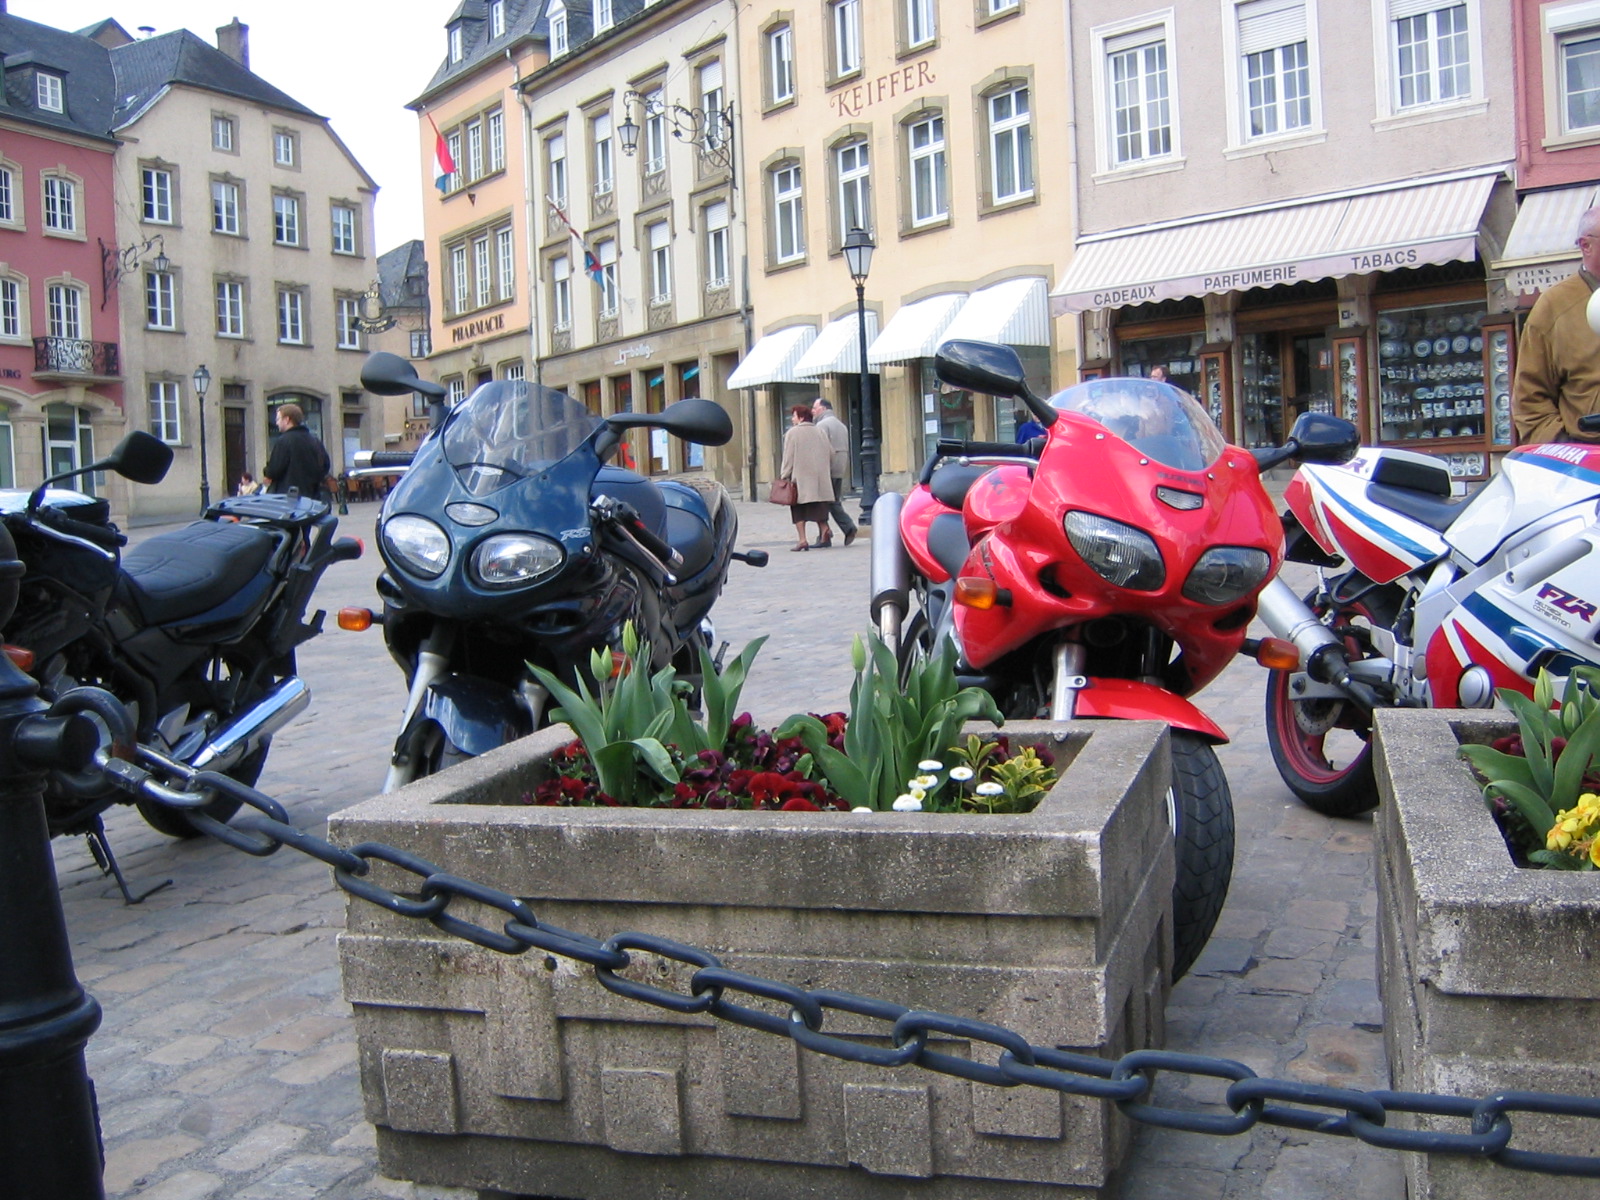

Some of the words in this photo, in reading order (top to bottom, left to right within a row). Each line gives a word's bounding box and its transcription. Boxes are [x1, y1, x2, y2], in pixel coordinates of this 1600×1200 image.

[830, 60, 937, 117] KEIFFER
[1351, 249, 1418, 270] TABACS
[1204, 265, 1297, 290] PARFUMERIE
[1517, 268, 1551, 278] FILMS
[1093, 285, 1157, 306] CADEAUX
[452, 313, 505, 343] PHARMACIE
[1532, 443, 1588, 465] YAMAHA
[1536, 582, 1598, 623] FZR
